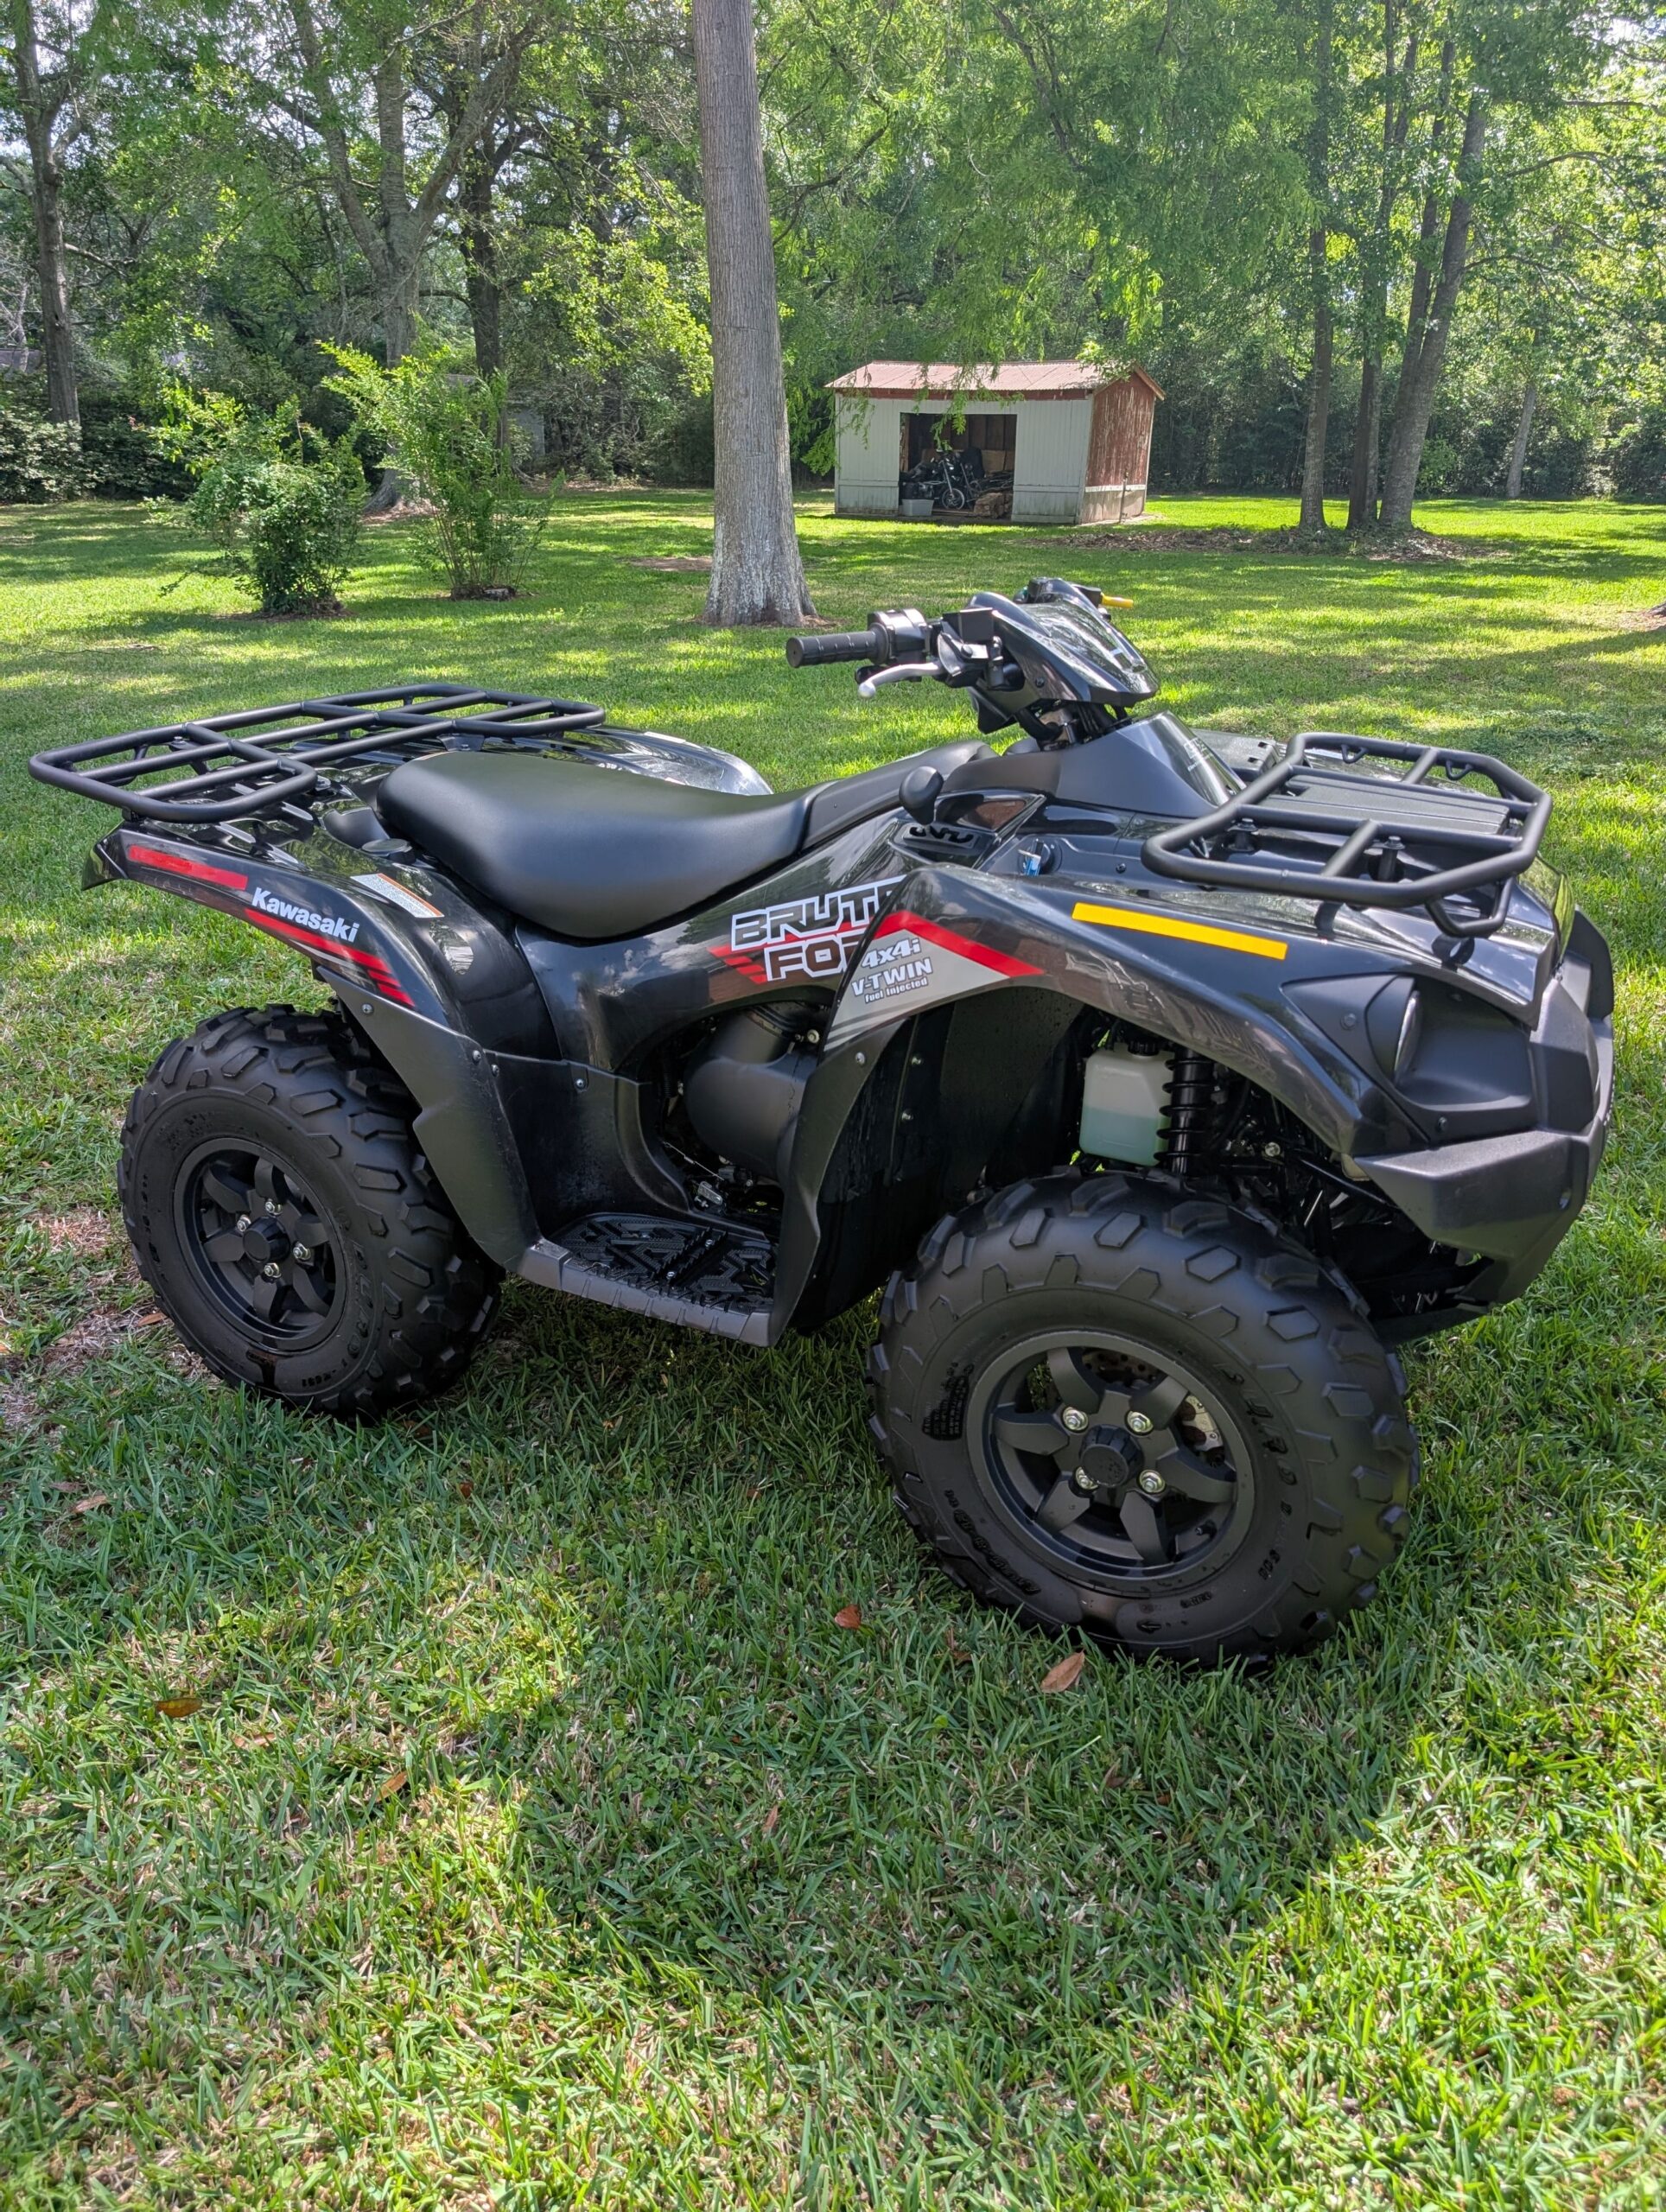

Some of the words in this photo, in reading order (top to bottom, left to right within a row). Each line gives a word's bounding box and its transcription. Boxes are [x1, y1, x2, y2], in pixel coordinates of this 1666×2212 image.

[251, 887, 360, 944] Kawasaki
[862, 938, 921, 969] 4x4i
[851, 957, 933, 996] V-TWIN
